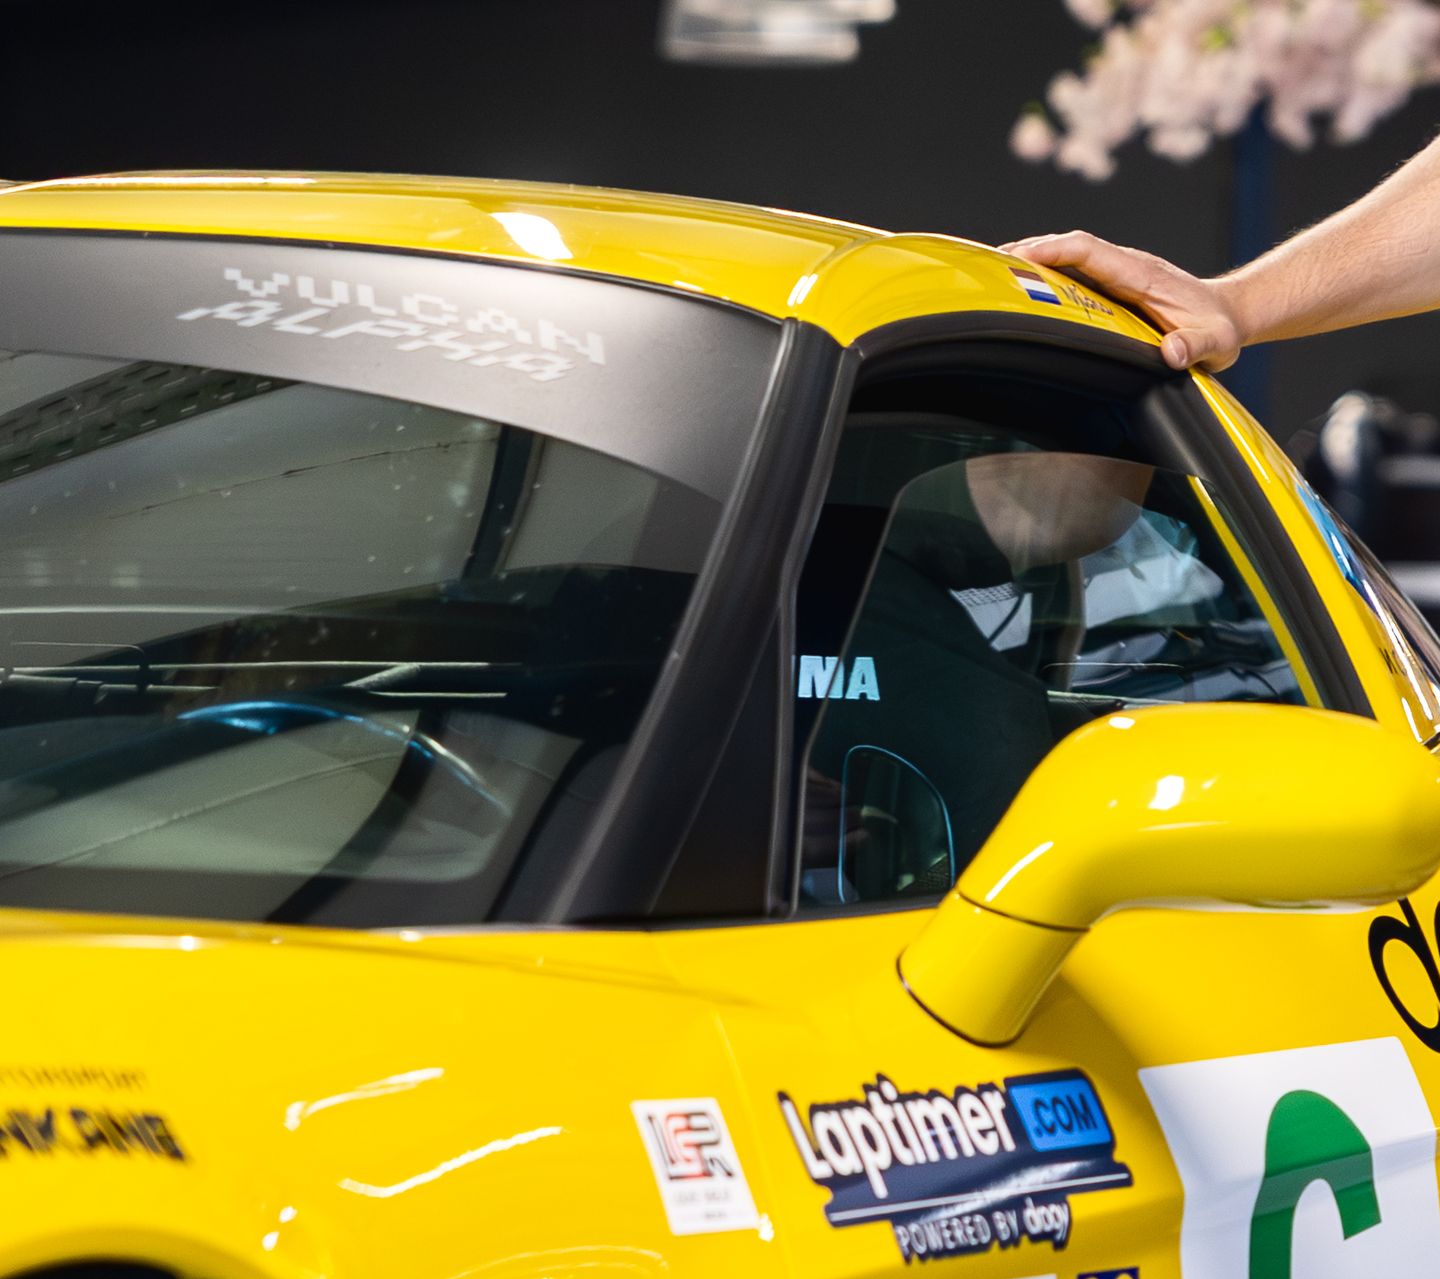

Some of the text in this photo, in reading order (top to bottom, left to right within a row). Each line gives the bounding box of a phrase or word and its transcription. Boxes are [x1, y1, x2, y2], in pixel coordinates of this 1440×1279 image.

[224, 268, 607, 365] VULCAN
[790, 654, 881, 702] MA
[895, 1213, 992, 1257] POWERED
[991, 1208, 1020, 1242] BY
